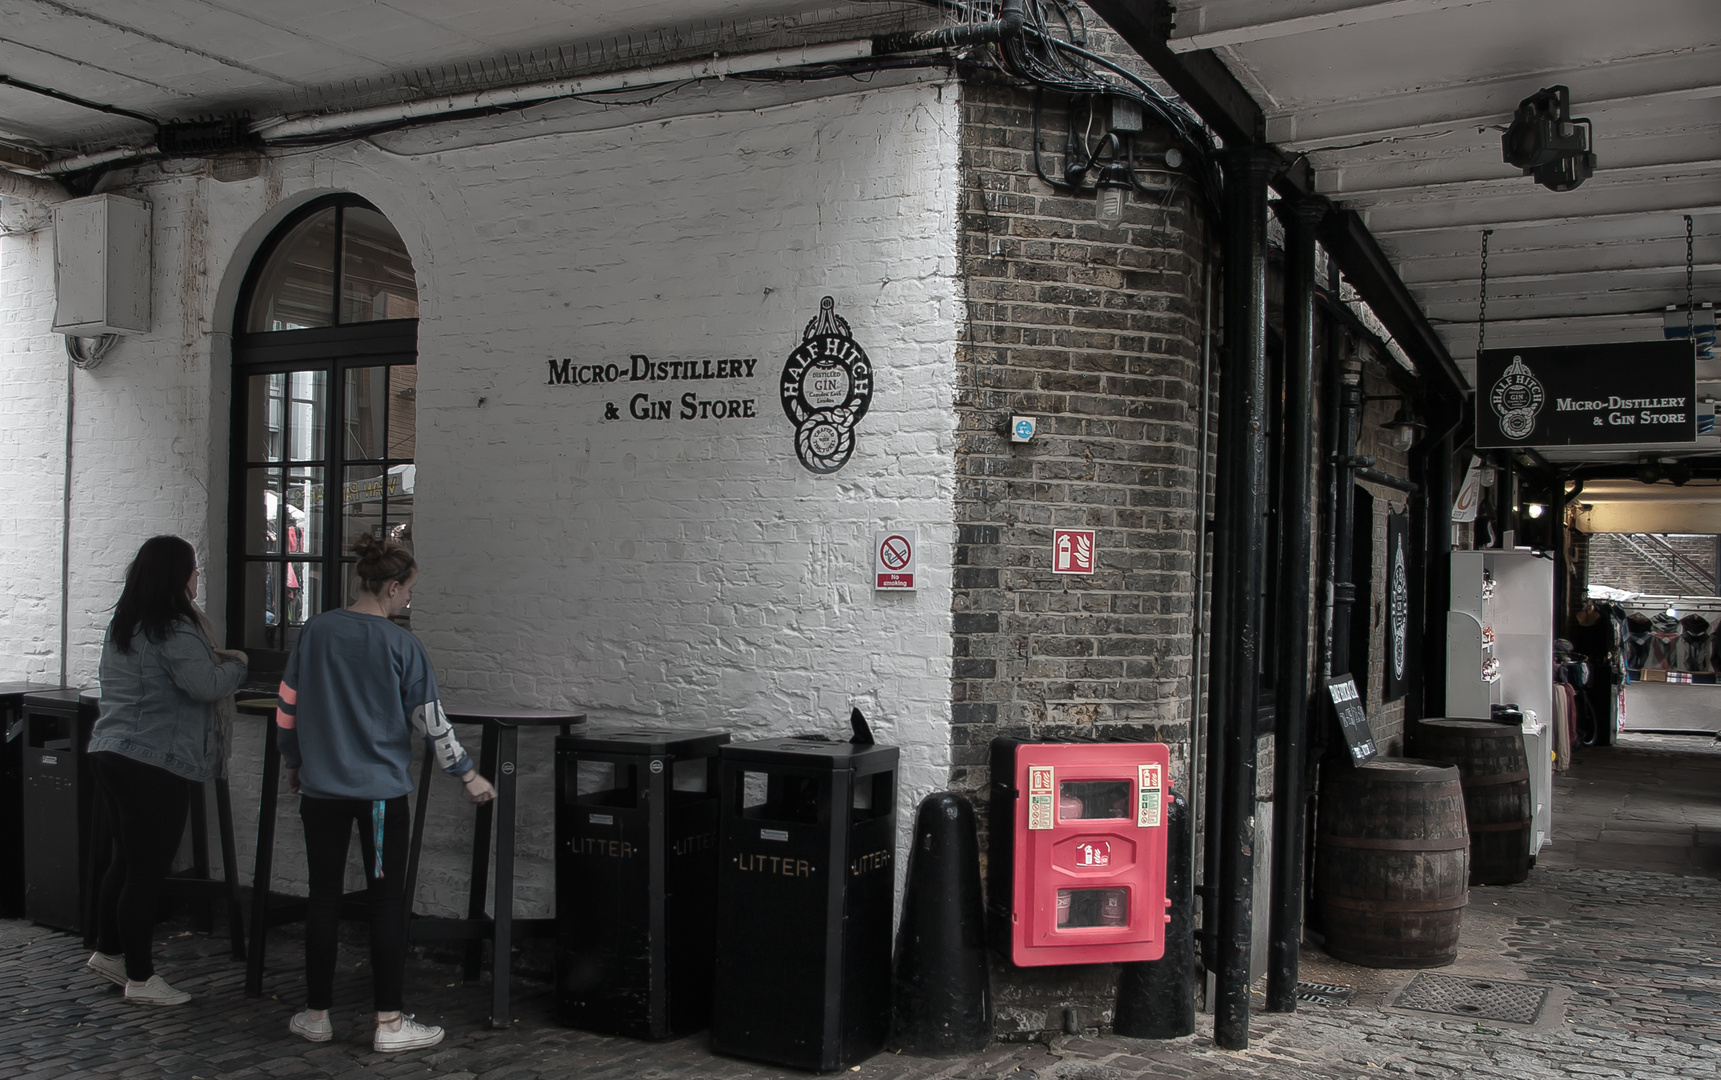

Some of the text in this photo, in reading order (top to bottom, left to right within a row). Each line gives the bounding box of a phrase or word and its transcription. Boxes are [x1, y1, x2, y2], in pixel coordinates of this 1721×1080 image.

[548, 354, 758, 386] MICRO-DISTILLERY
[784, 338, 869, 398] HALF HITCH
[814, 379, 837, 391] GIN
[1493, 375, 1542, 404] HALF HITCH
[604, 392, 756, 421] & GIN STORE
[1555, 395, 1686, 412] MICRO-DISTILLERY
[1593, 410, 1686, 426] & GIN STORE
[883, 580, 908, 588] smoking
[890, 573, 900, 581] No
[571, 836, 632, 859] LITTER
[739, 852, 809, 878] LITTER
[853, 849, 888, 876] LITTER
